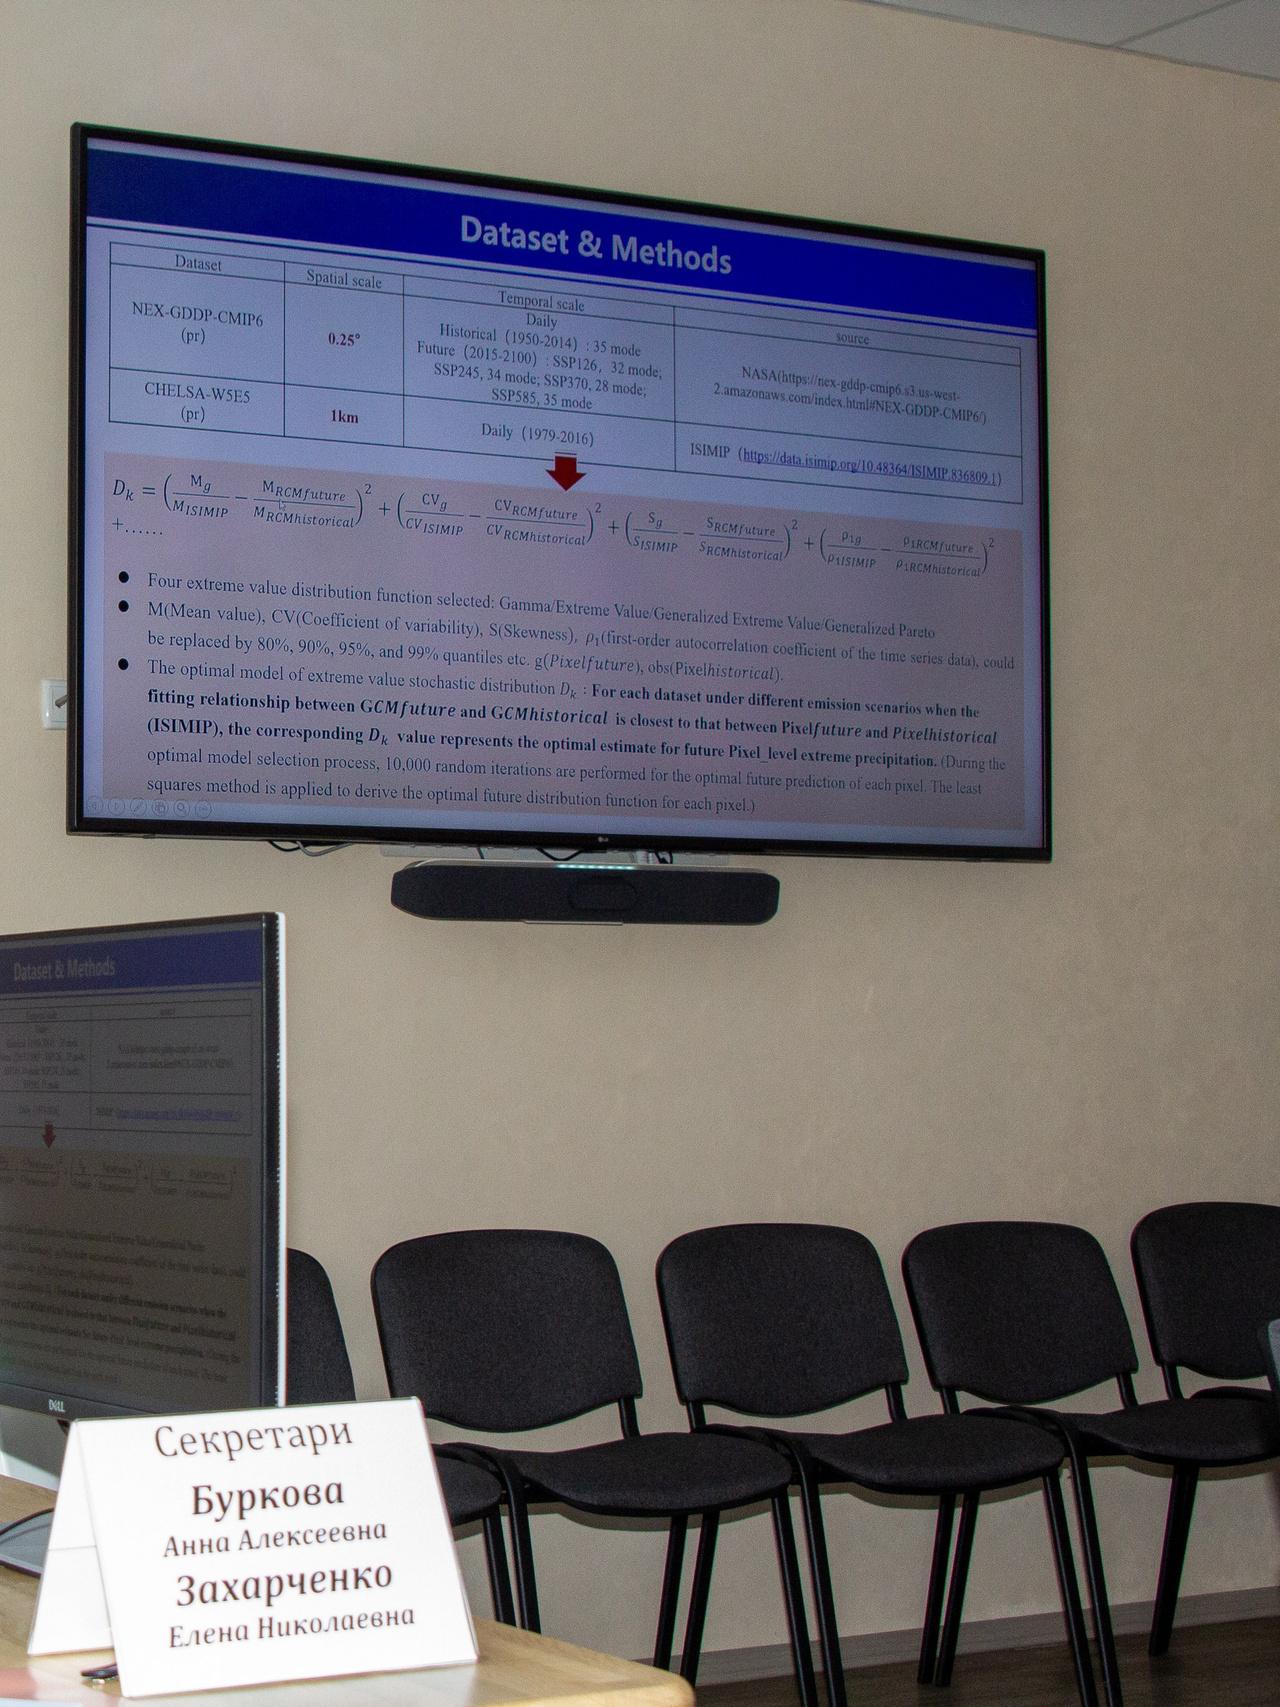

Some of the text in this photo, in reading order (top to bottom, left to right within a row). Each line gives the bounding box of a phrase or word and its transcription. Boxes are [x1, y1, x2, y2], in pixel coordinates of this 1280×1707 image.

[460, 214, 732, 275] Dataset & Methods
[175, 253, 222, 273] Dataset
[306, 267, 382, 290] Spatial scale
[132, 301, 263, 326] NEX-GDDP-CMIP6
[498, 289, 585, 313] Temporal scale
[181, 327, 205, 345] (pr)
[526, 312, 557, 331] Daily
[440, 322, 641, 357] Historical (1950-2014) 35 mode
[836, 333, 869, 345] source
[417, 340, 455, 356] Future
[463, 344, 536, 367] (2015-2100)
[611, 360, 624, 374] 32
[628, 364, 662, 380] mode;
[144, 381, 250, 403] CHELSA-W5E5
[434, 362, 646, 397] SSP245, 34 mode; SSP370, 28 mode;
[180, 406, 205, 423] (pr)
[491, 388, 592, 409] SSP585, 35 mode
[331, 409, 358, 423] 1km
[481, 422, 593, 447] Daily (1979-2016)
[690, 442, 730, 458] ISIMIP
[148, 572, 935, 638] Four extreme value distribution function selected: Gamma/Extreme Value/Generalized Extreme Value/Generalized Pareto
[148, 601, 210, 619] M(Mean
[217, 606, 265, 623] value),
[271, 609, 379, 629] CV(Coefficient
[385, 616, 400, 630] of
[404, 618, 483, 638] variability),
[489, 622, 577, 644] S(Skewness),
[674, 637, 768, 653] autocorrelation
[772, 642, 836, 657] coefficient
[840, 646, 854, 659] of
[858, 646, 875, 660] the
[880, 650, 905, 662] time
[910, 650, 942, 664] series
[947, 652, 978, 668] data),
[983, 655, 1014, 669] could
[147, 629, 783, 684] be replaced by 80%, 90%, 95%, and 99% quantiles etc. g(Pixelfuture), obs(Pixelhistorical).
[147, 659, 175, 674] The
[180, 662, 234, 680] optimal
[240, 665, 283, 680] model
[288, 667, 305, 681] of
[307, 671, 363, 684] extreme
[368, 671, 404, 686] value
[409, 674, 475, 690] stochastic
[479, 677, 555, 694] distribution
[592, 683, 616, 697] For
[619, 686, 649, 699] each
[654, 687, 700, 702] dataset
[706, 691, 744, 704] under
[748, 692, 803, 707] different
[807, 697, 860, 711] emission
[864, 701, 921, 714] scenarios
[925, 703, 956, 716] when
[960, 705, 979, 717] the
[147, 688, 194, 707] fitting
[200, 691, 289, 713] relationship
[295, 695, 354, 712] between
[460, 705, 486, 718] and
[616, 712, 625, 725] is
[630, 713, 673, 727] closest
[677, 717, 690, 728] to
[694, 716, 719, 729] that
[725, 717, 776, 732] between
[865, 725, 887, 738] and
[147, 717, 223, 735] (ISIMIP),
[228, 721, 251, 735] the
[256, 726, 363, 743] corresponding
[397, 729, 435, 743] value
[440, 735, 512, 749] represents
[517, 734, 538, 748] the
[543, 737, 595, 753] optimal
[600, 739, 656, 753] estimate
[660, 741, 680, 754] for
[684, 742, 723, 756] future
[800, 751, 851, 762] extreme
[855, 752, 937, 768] precipitation.
[940, 754, 985, 773] (During
[988, 756, 1005, 770] the
[147, 746, 575, 777] optimal model selection process, 10,000 random iterations are
[13, 955, 116, 981] Dataset & Methods
[154, 1419, 353, 1461] Секретари
[192, 1481, 345, 1522] Буркова
[164, 1522, 388, 1558] Анна Алексеевна
[177, 1563, 392, 1607] Захарченко
[169, 1608, 415, 1648] Елена Николаевна
